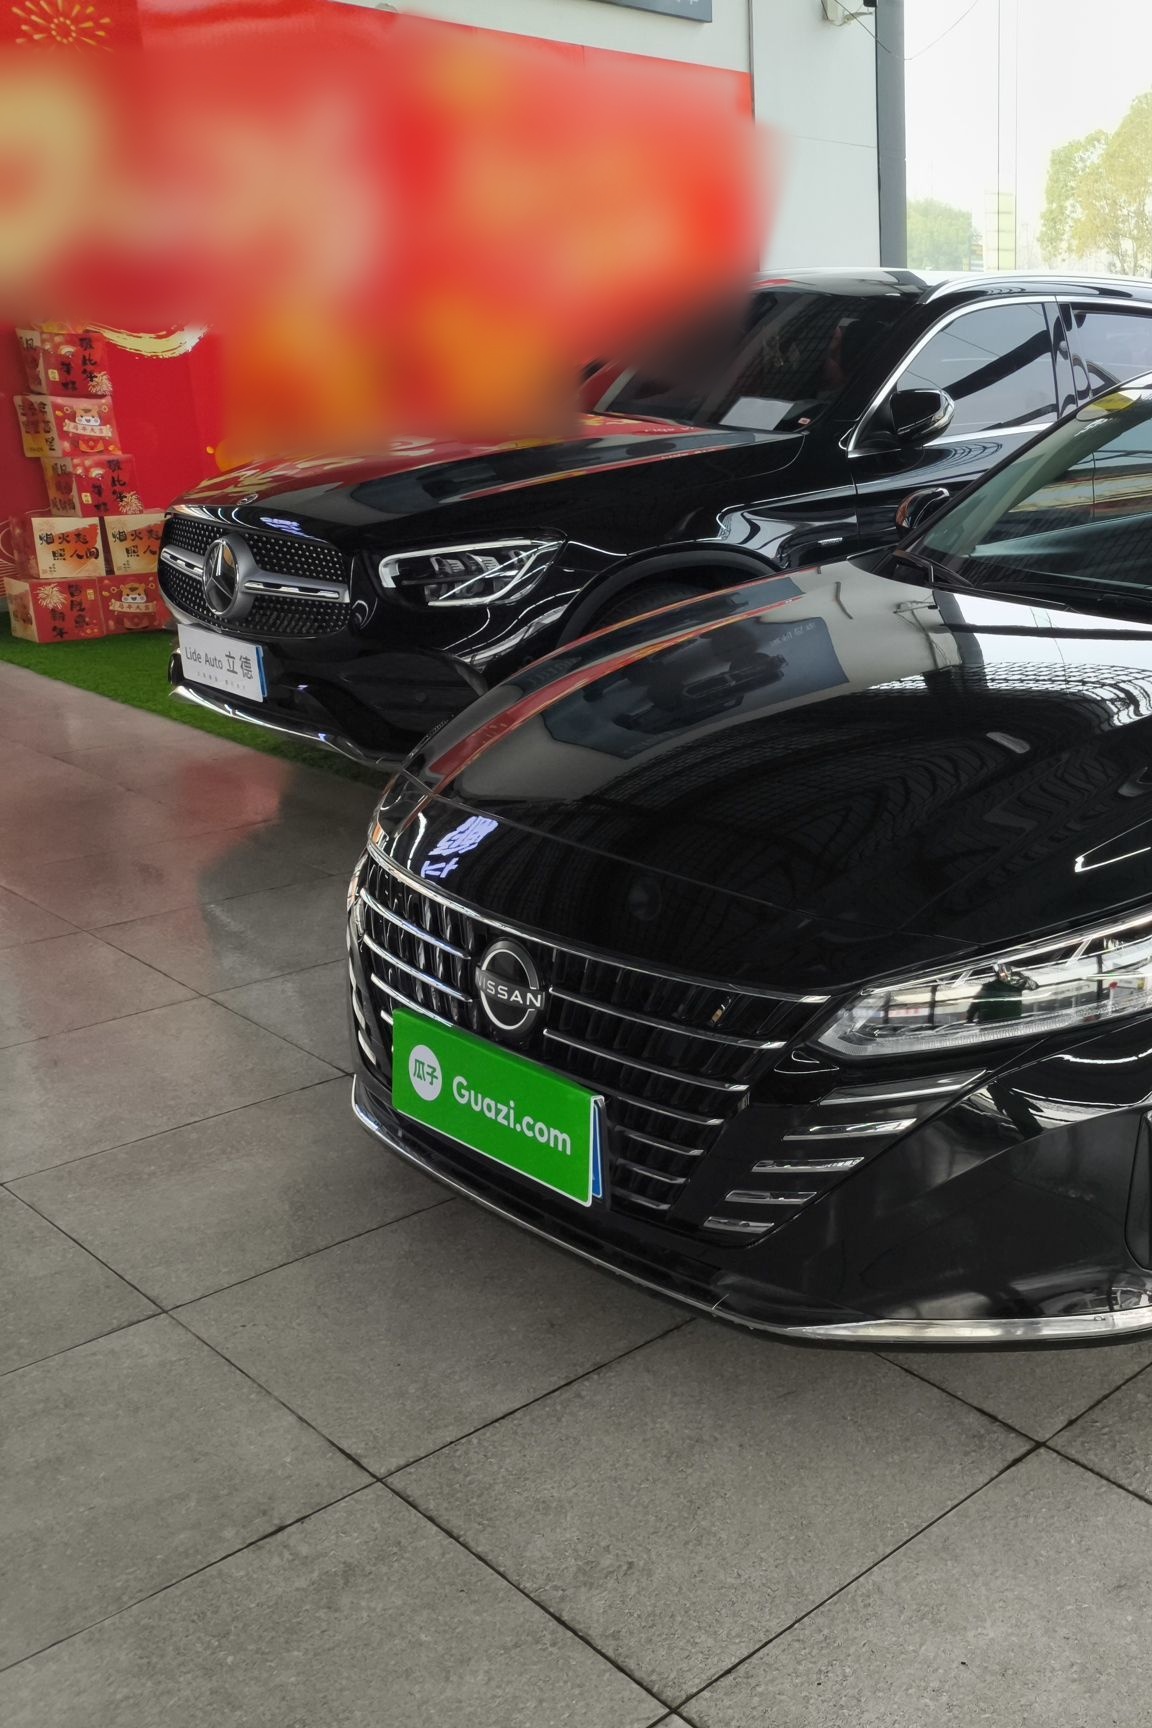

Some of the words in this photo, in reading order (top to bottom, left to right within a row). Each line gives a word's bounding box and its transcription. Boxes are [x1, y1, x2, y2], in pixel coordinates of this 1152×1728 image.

[52, 546, 100, 561] 照人间
[184, 646, 202, 664] Lide
[204, 652, 223, 670] Auto
[225, 651, 254, 680] 立德
[413, 1058, 439, 1087] 瓜子
[453, 1075, 572, 1156] Guazi.com
